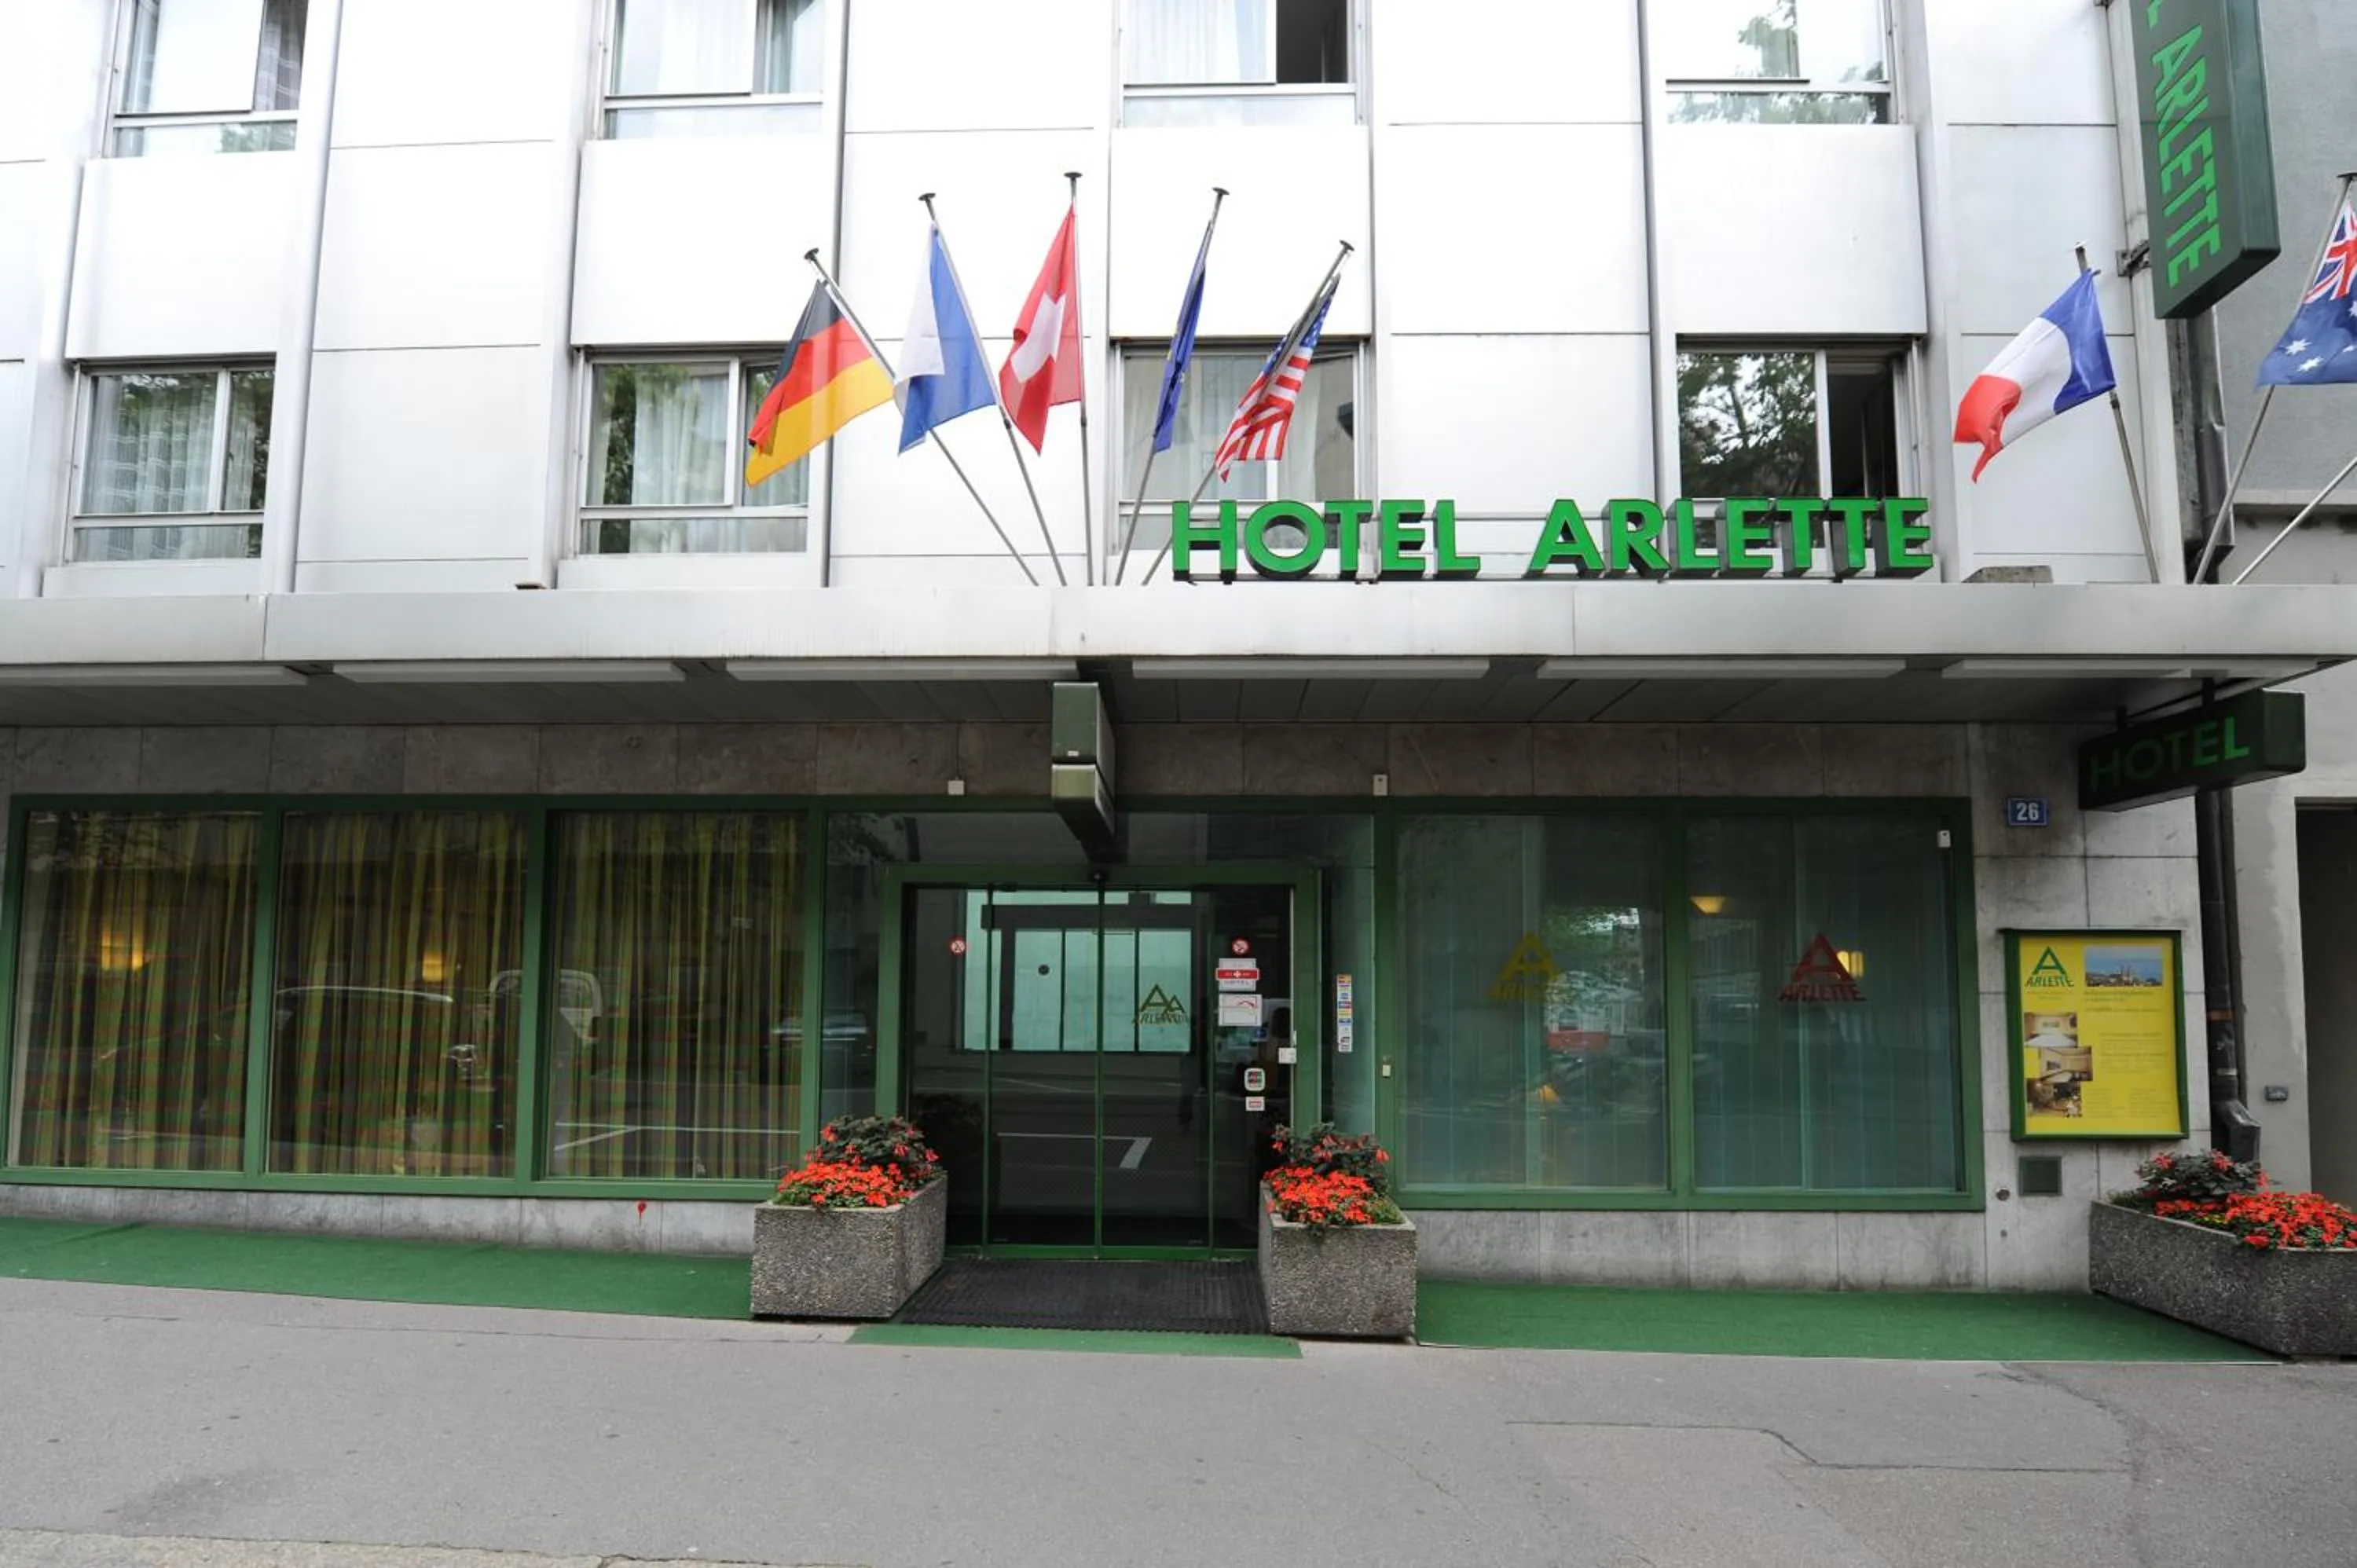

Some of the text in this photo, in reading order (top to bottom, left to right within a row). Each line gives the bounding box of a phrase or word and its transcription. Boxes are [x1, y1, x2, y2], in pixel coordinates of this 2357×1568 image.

[2152, 24, 2221, 288] ARLETTE
[1171, 498, 1933, 576] HOTEL ARLETTE
[2090, 716, 2249, 793] HOTEL
[2017, 802, 2039, 821] 26
[1778, 982, 1868, 1002] ARLETTE
[2025, 974, 2074, 987] ARLETTE
